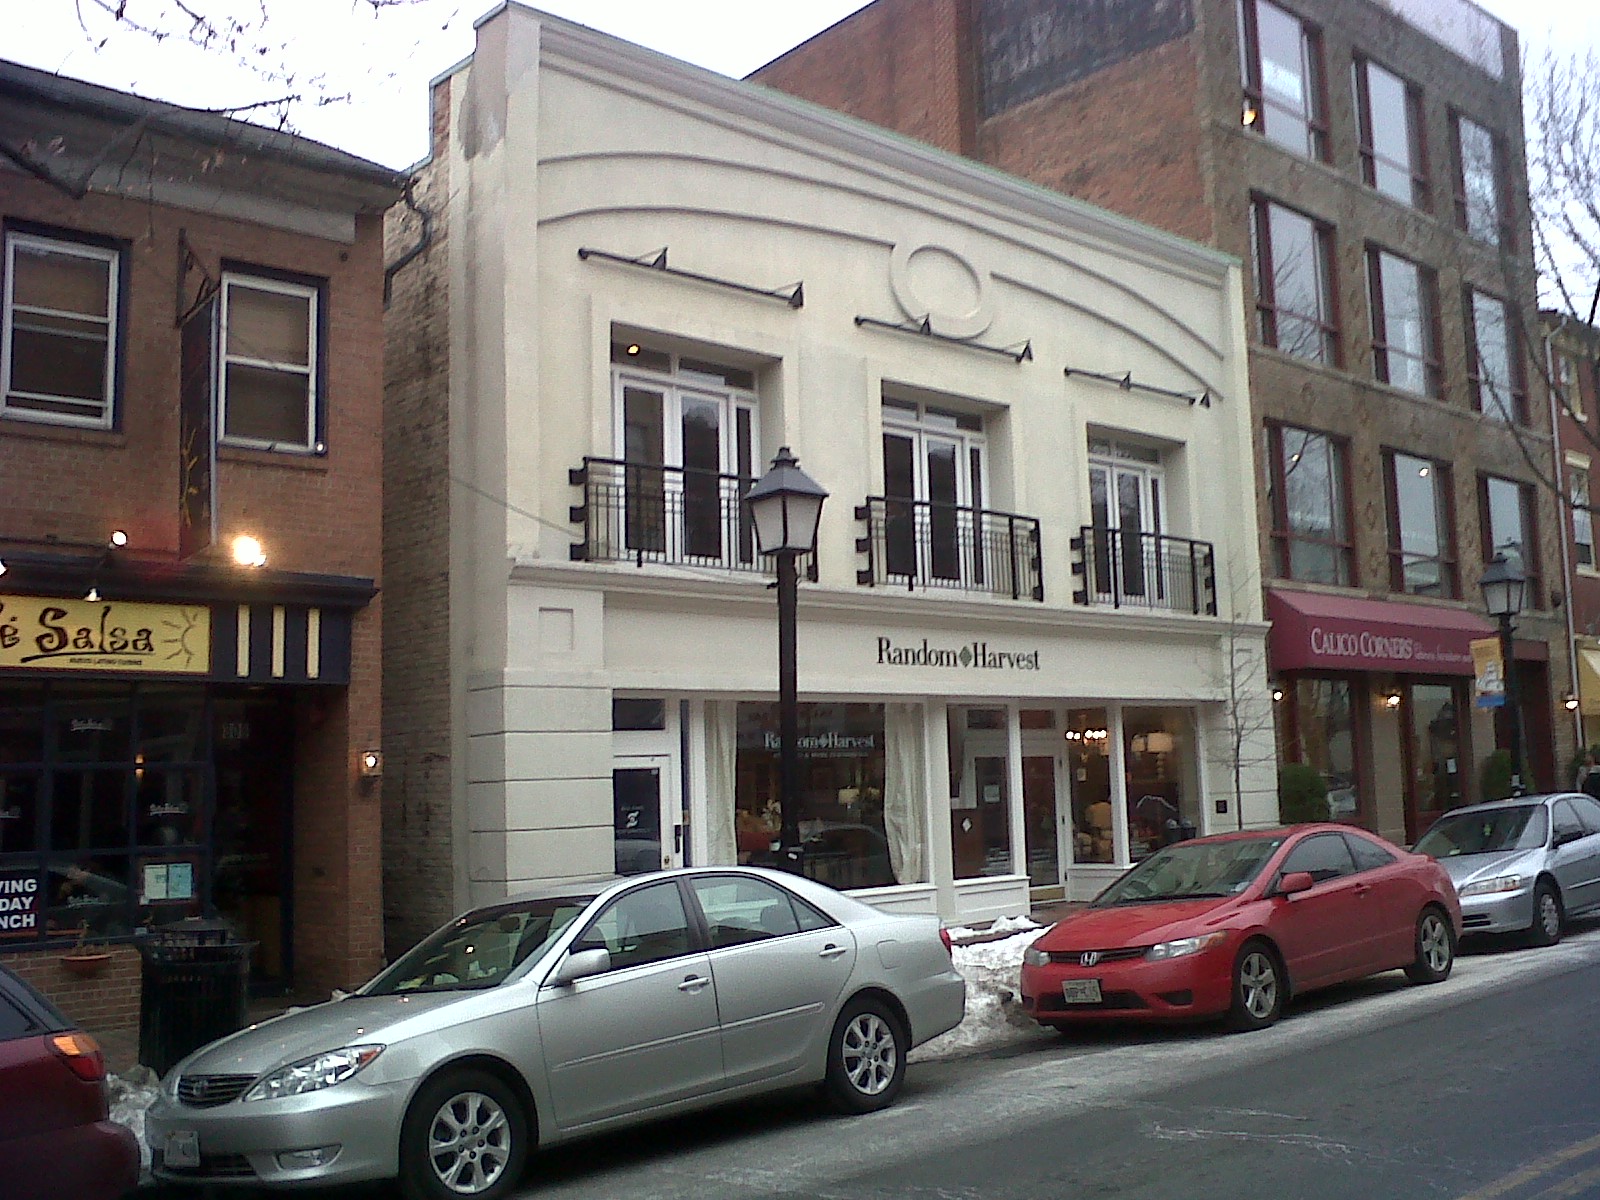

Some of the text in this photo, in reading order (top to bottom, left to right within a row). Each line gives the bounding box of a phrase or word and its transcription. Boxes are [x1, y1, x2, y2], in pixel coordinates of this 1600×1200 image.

[36, 605, 154, 654] Salsa
[1311, 627, 1358, 656] CALICO
[1360, 631, 1413, 660] CORNERS
[877, 636, 1041, 671] Random Harvest
[765, 732, 819, 750] Raom
